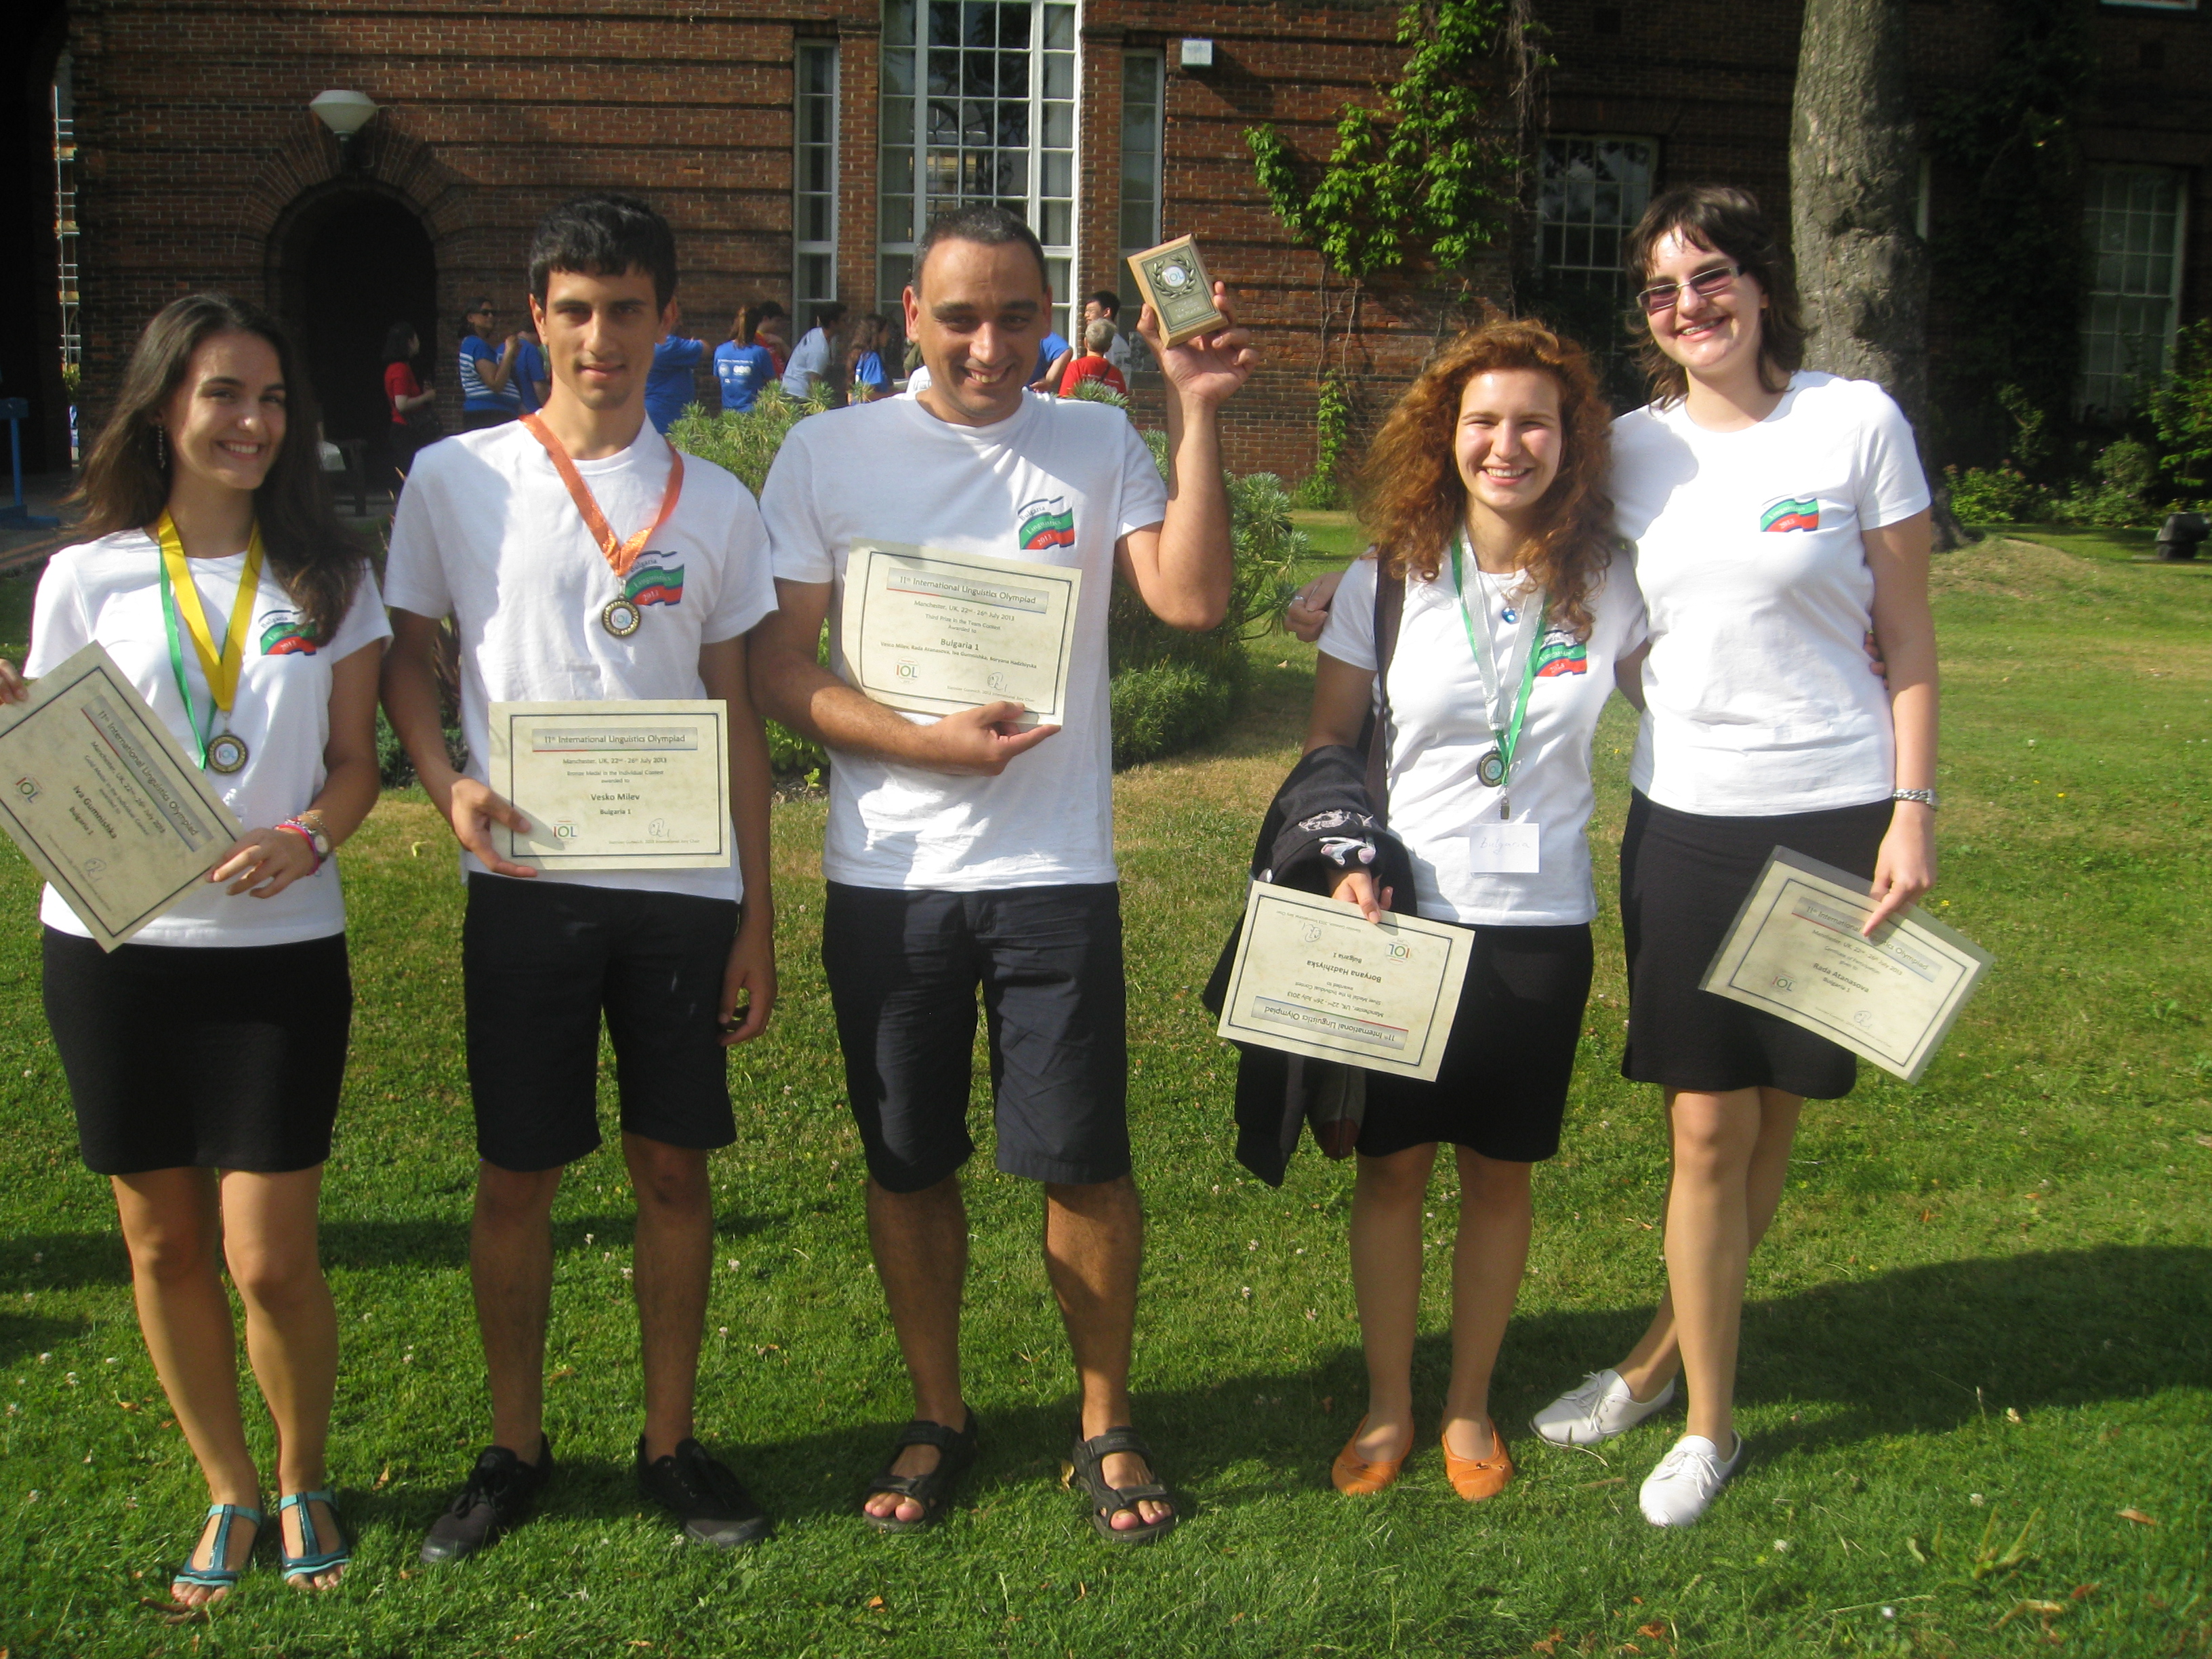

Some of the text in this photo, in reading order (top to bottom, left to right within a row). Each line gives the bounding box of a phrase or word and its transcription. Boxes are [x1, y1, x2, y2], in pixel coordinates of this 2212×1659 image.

[1164, 271, 1184, 283] IOL
[1020, 506, 1045, 520] Bulgaria
[1767, 505, 1806, 519] Linguistics
[1026, 520, 1061, 534] Linguistics
[1778, 518, 1795, 529] 2013
[1037, 533, 1052, 546] 2013
[913, 578, 959, 591] International
[962, 586, 997, 599] Linguistics
[999, 592, 1036, 605] Olympiad
[914, 600, 947, 611] Manchester,
[940, 638, 972, 650] Bulgaria
[896, 664, 918, 678] IOL
[609, 735, 644, 744] Linguistics
[647, 735, 685, 744] Olympiad
[106, 722, 146, 769] International
[139, 766, 171, 802] Linguistics
[165, 799, 199, 838] Olympiad
[14, 776, 41, 804] IOL
[68, 806, 91, 832] Bulgaria
[73, 785, 119, 840] Iva Gumnishka
[553, 825, 577, 838] IOL
[1818, 911, 1861, 933] International
[1893, 946, 1929, 970] Olympiad
[1386, 943, 1410, 958] IOL
[1337, 952, 1362, 964] Bulgaria
[1305, 959, 1382, 983] Boryana Hadzhiyska
[1812, 962, 1870, 993] Rada Atanasova
[1889, 965, 1903, 976] 2013
[1771, 975, 1796, 992] IOL
[1822, 976, 1846, 991] Bulgaria
[1300, 993, 1312, 1001] July
[1264, 1004, 1300, 1020] Olympiad
[1301, 1012, 1336, 1028] Linguistics
[1337, 1023, 1382, 1038] International
